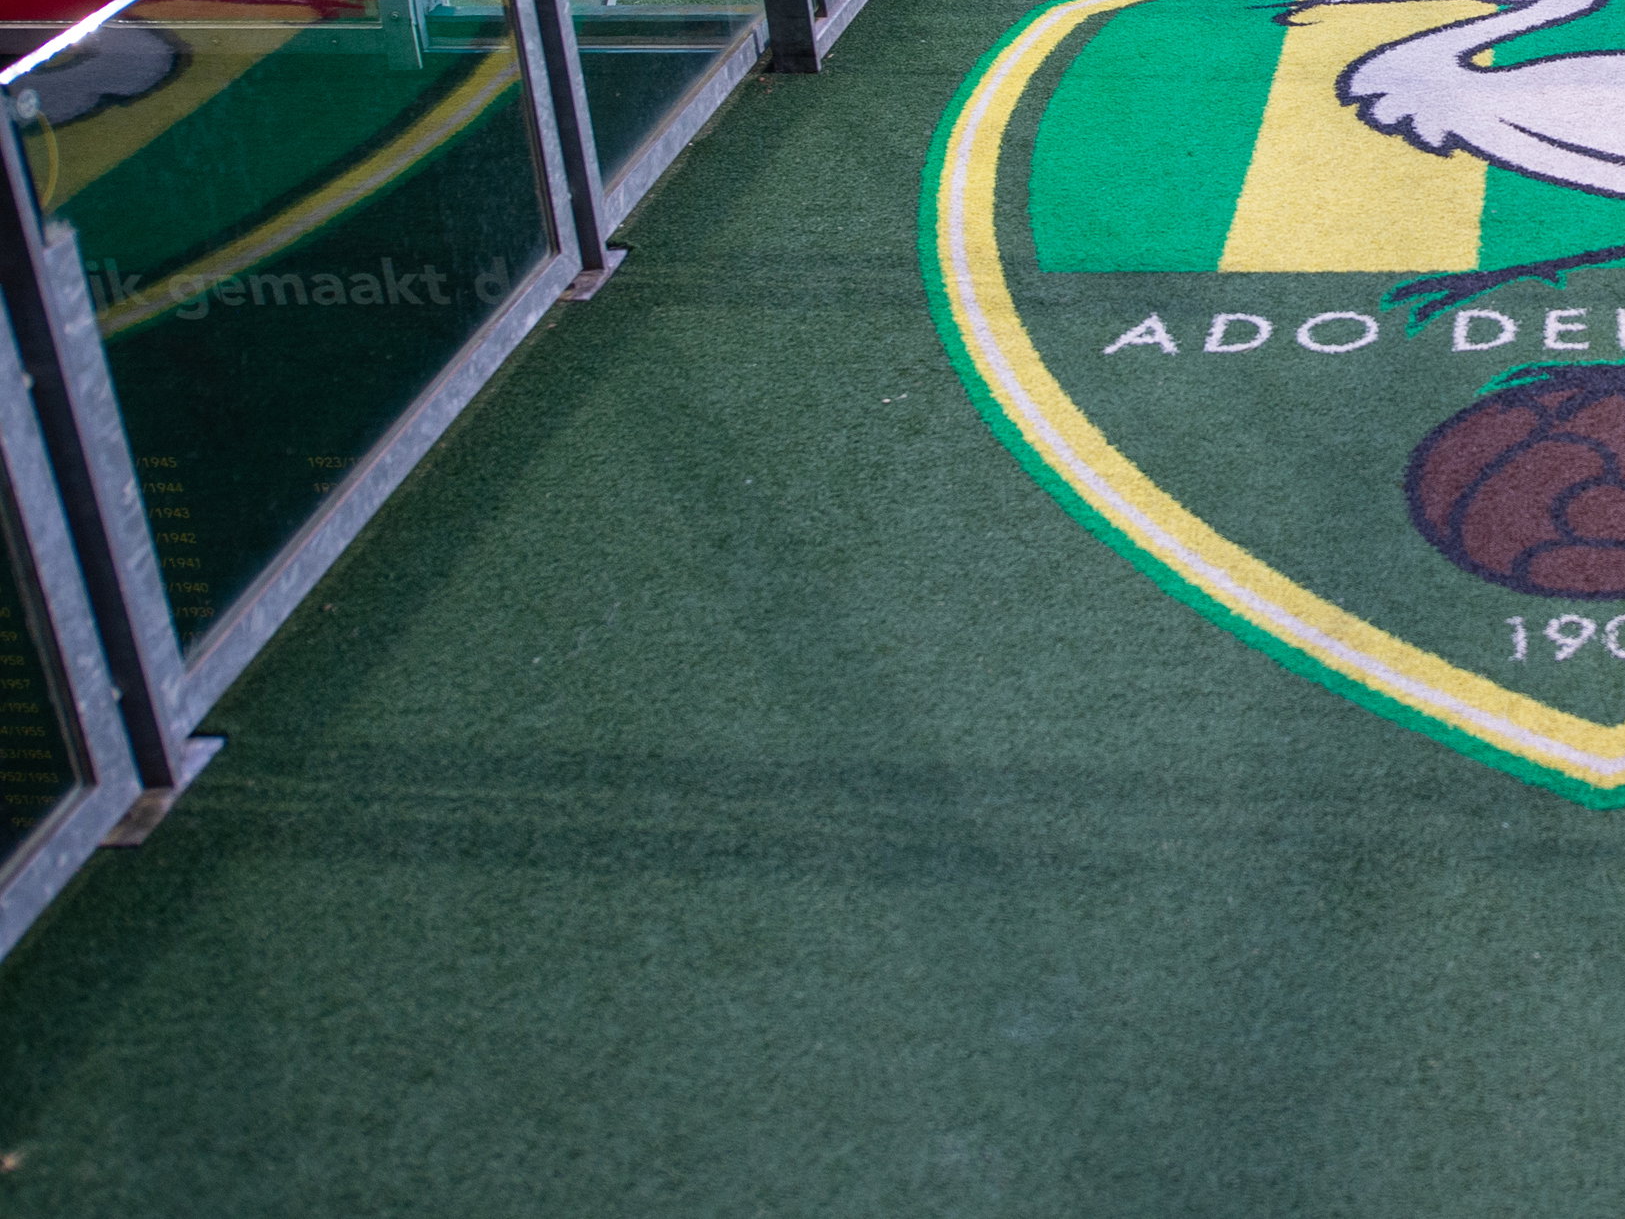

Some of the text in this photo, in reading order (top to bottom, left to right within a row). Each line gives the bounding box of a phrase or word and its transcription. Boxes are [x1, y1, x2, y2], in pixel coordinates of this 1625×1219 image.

[169, 256, 453, 320] gemaakt
[1103, 311, 1380, 355] ADO
[136, 456, 178, 469] /1945
[143, 482, 185, 495] /1944
[149, 507, 192, 519] /1943
[156, 532, 199, 544] /1942
[162, 557, 202, 569] /1941
